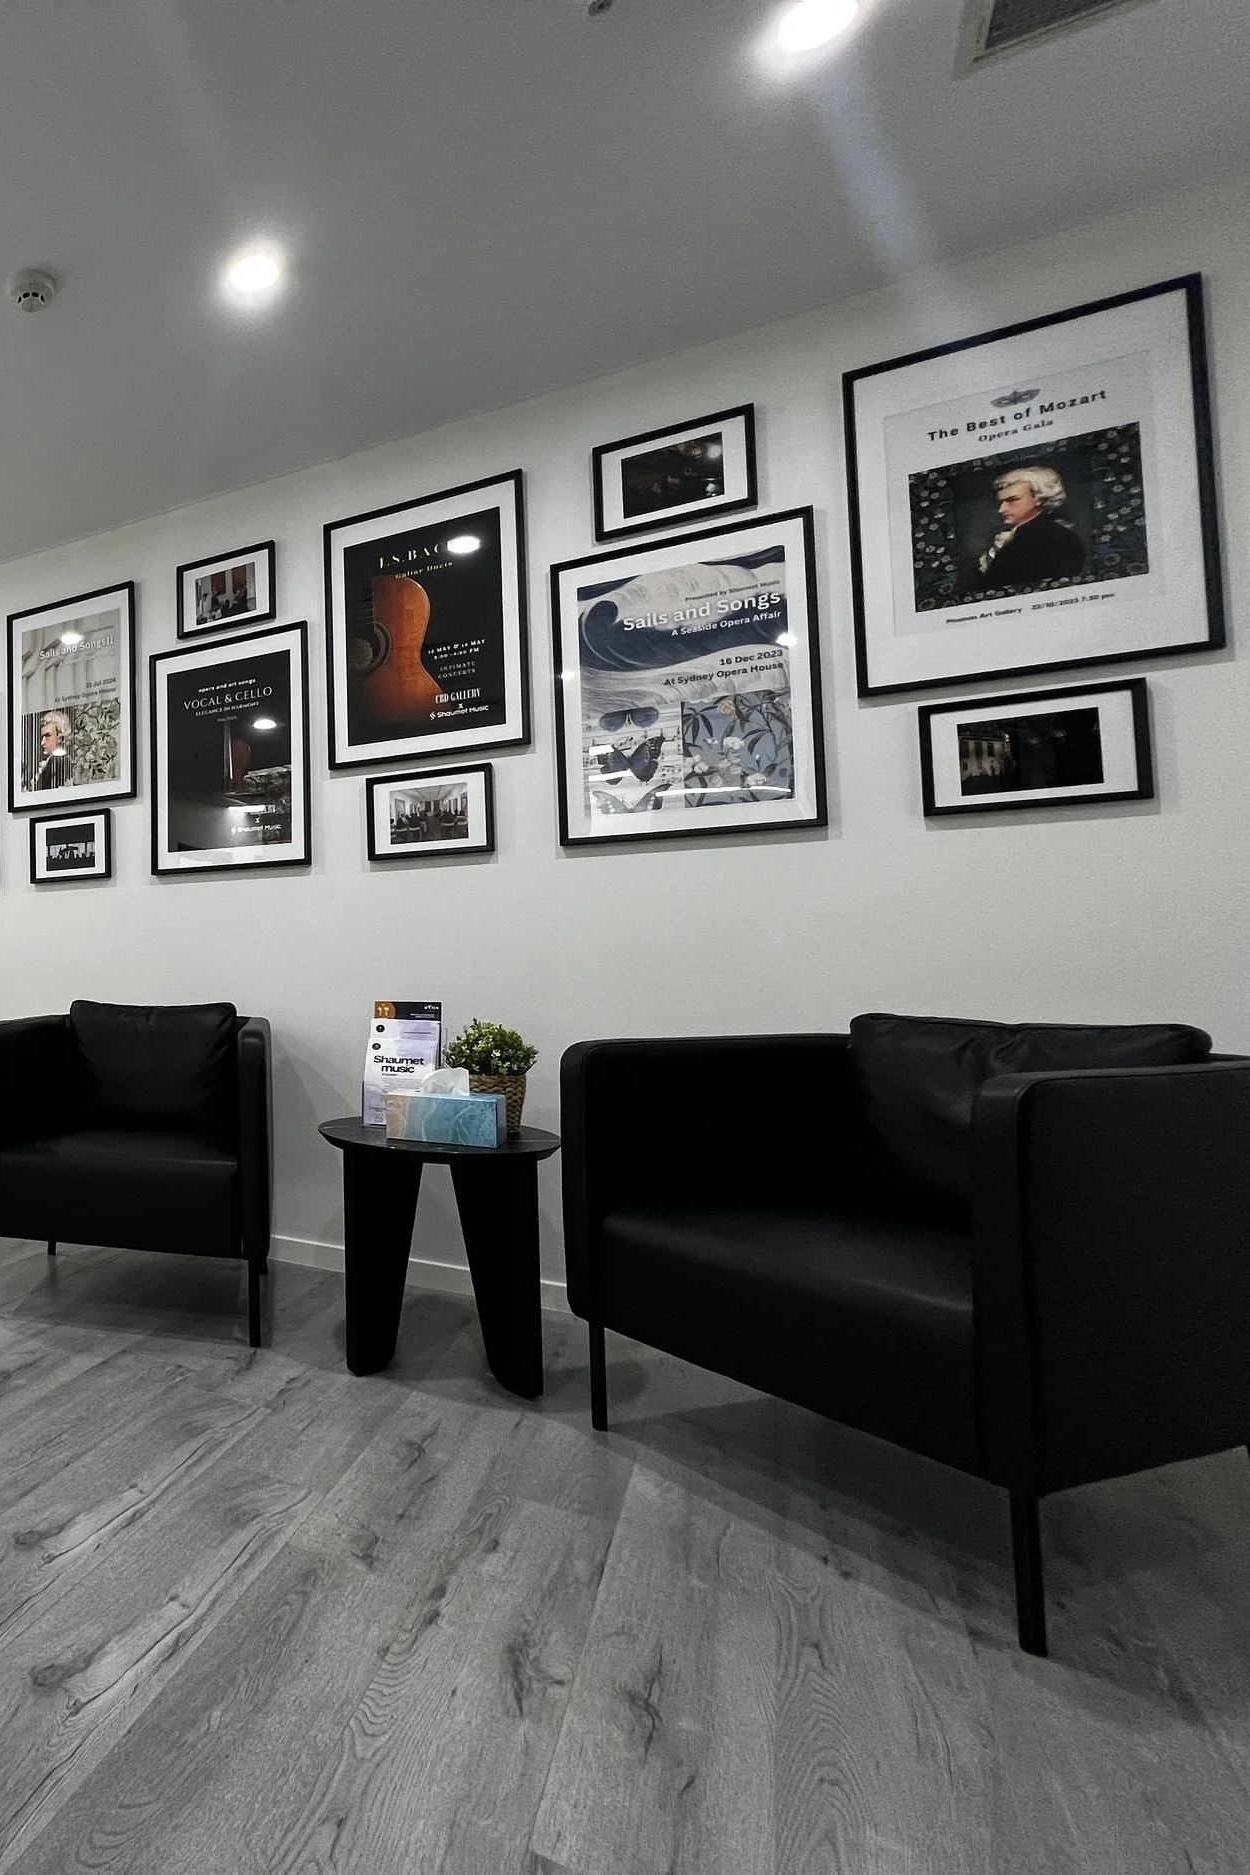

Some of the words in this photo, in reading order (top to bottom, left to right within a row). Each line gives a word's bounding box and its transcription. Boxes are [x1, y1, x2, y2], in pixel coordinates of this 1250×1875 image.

[927, 428, 959, 442] The
[966, 415, 1006, 433] Best
[1013, 407, 1032, 421] of
[1039, 390, 1107, 414] Mozart
[978, 427, 1018, 442] Opera
[1023, 418, 1054, 431] Gala
[685, 590, 718, 602] Presented
[719, 588, 728, 597] by
[623, 612, 668, 632] Sails
[673, 602, 710, 622] and
[716, 592, 781, 614] Songs
[979, 611, 993, 619] Art
[994, 606, 1023, 617] Gallery
[681, 622, 718, 635] Seaside
[720, 616, 751, 629] Opera
[752, 610, 782, 622] Affair
[39, 648, 60, 660] Sails
[61, 643, 78, 655] and
[436, 645, 451, 653] MAY
[470, 638, 486, 646] MAY
[719, 657, 733, 666] 16
[735, 655, 755, 664] Dec
[757, 649, 784, 661] 2023
[238, 678, 256, 686] songs
[664, 677, 676, 686] At
[677, 671, 715, 686] Sydney
[716, 666, 749, 681] Opera
[750, 661, 784, 673] House
[183, 696, 222, 710] VOCAL
[224, 693, 233, 703] &
[234, 686, 273, 702] CELLO
[435, 693, 449, 704] CBD
[450, 687, 481, 702] GALLERY
[195, 707, 223, 716] ELEGANCE
[437, 708, 468, 718] Shaumet
[469, 704, 489, 713] Music
[373, 1055, 425, 1066] Shaumet
[381, 1065, 415, 1074] music
